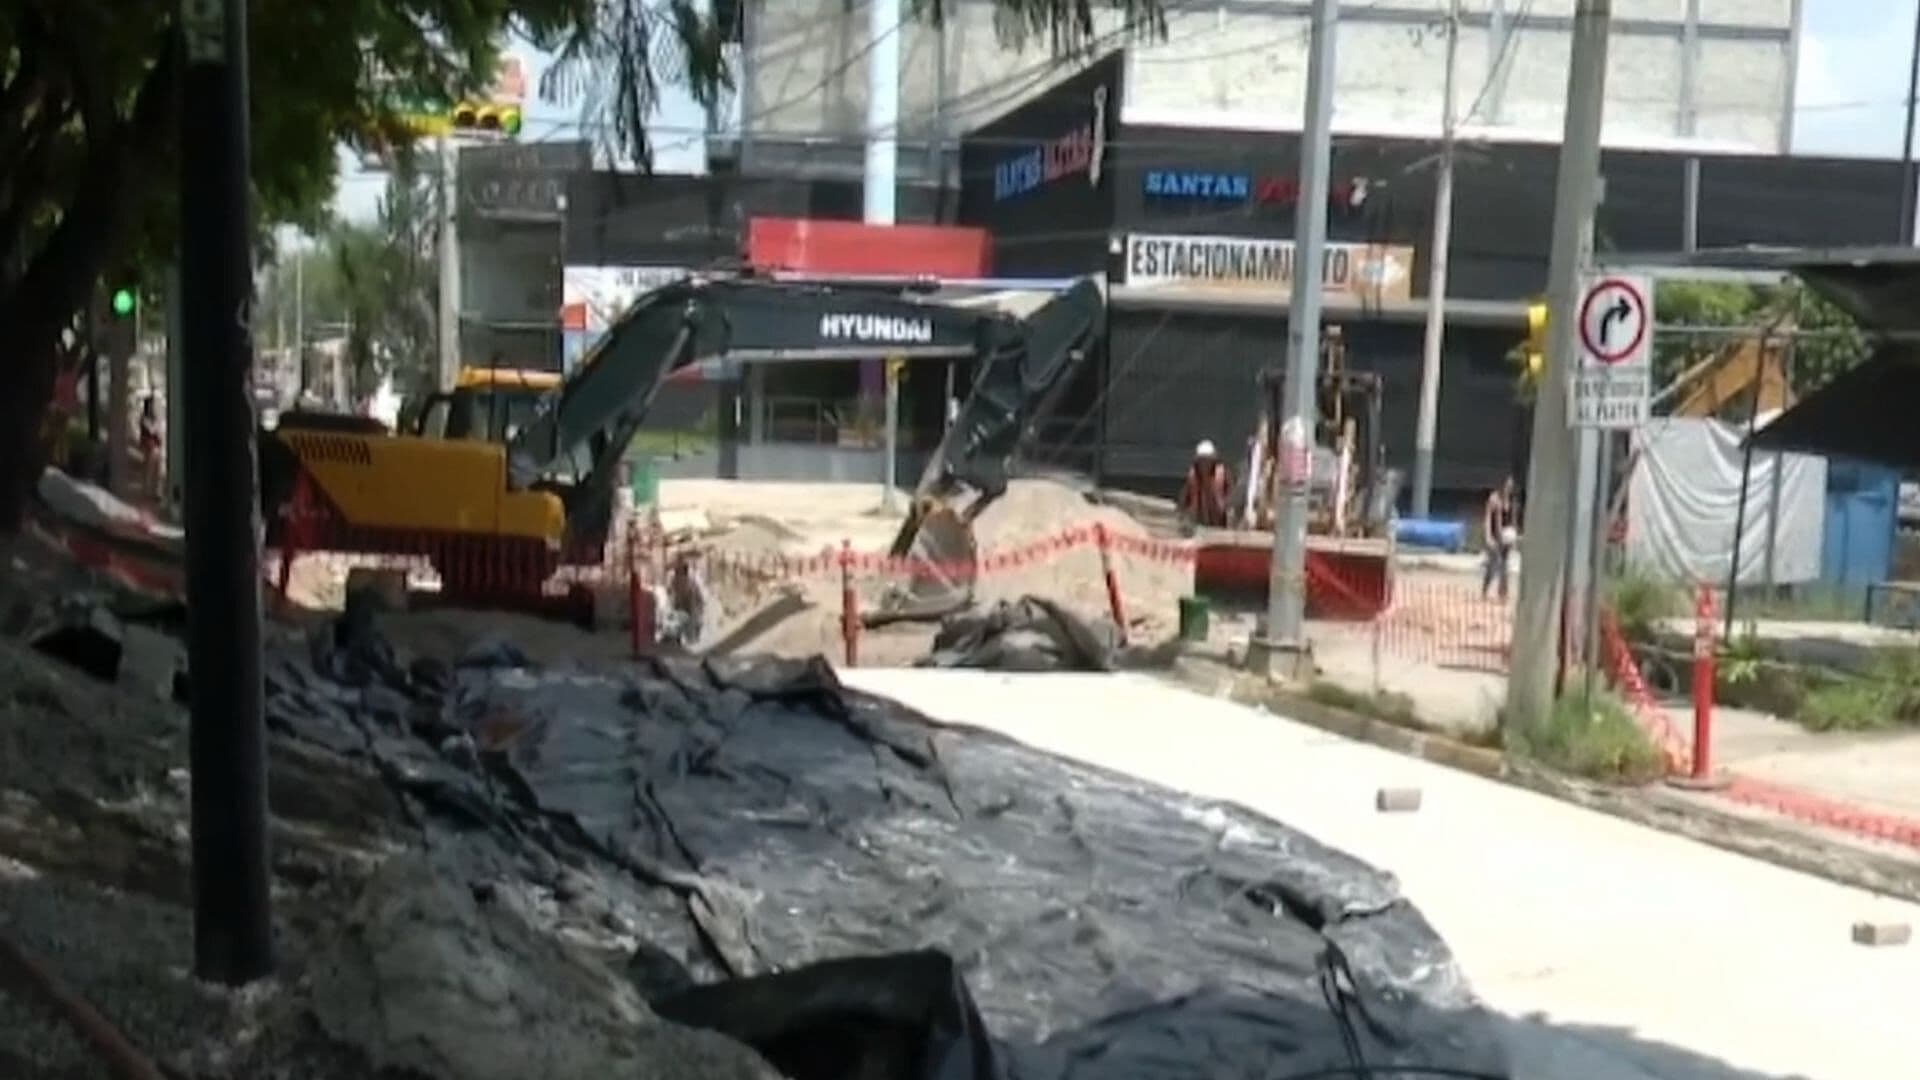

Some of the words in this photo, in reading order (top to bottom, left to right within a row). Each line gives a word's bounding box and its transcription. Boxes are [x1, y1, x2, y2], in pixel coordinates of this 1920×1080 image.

[1145, 172, 1248, 197] SANTAS
[1131, 239, 1348, 283] ESTACIONAMITO
[821, 313, 932, 341] HYUNDAI
